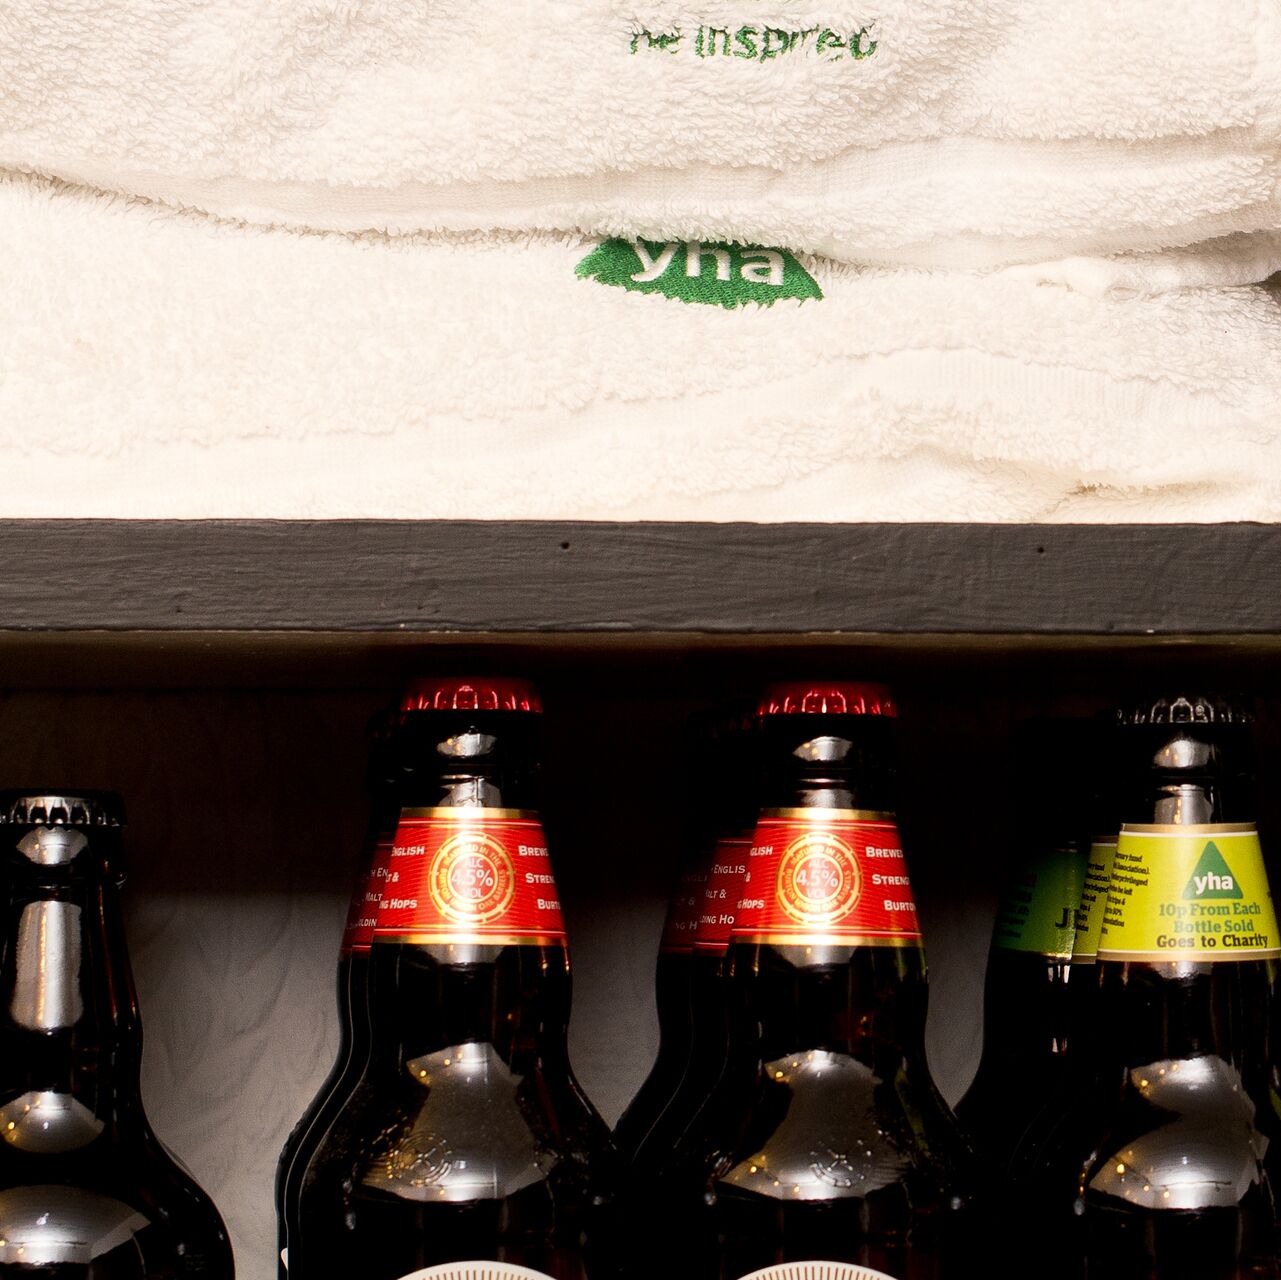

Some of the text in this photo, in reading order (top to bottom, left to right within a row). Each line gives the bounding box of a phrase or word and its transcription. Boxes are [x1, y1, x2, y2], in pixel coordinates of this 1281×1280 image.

[1193, 871, 1234, 895] yha
[1158, 901, 1261, 920] 10p From Each
[1174, 919, 1255, 933] Bottle Sold
[1156, 933, 1268, 949] Goes to Charity
